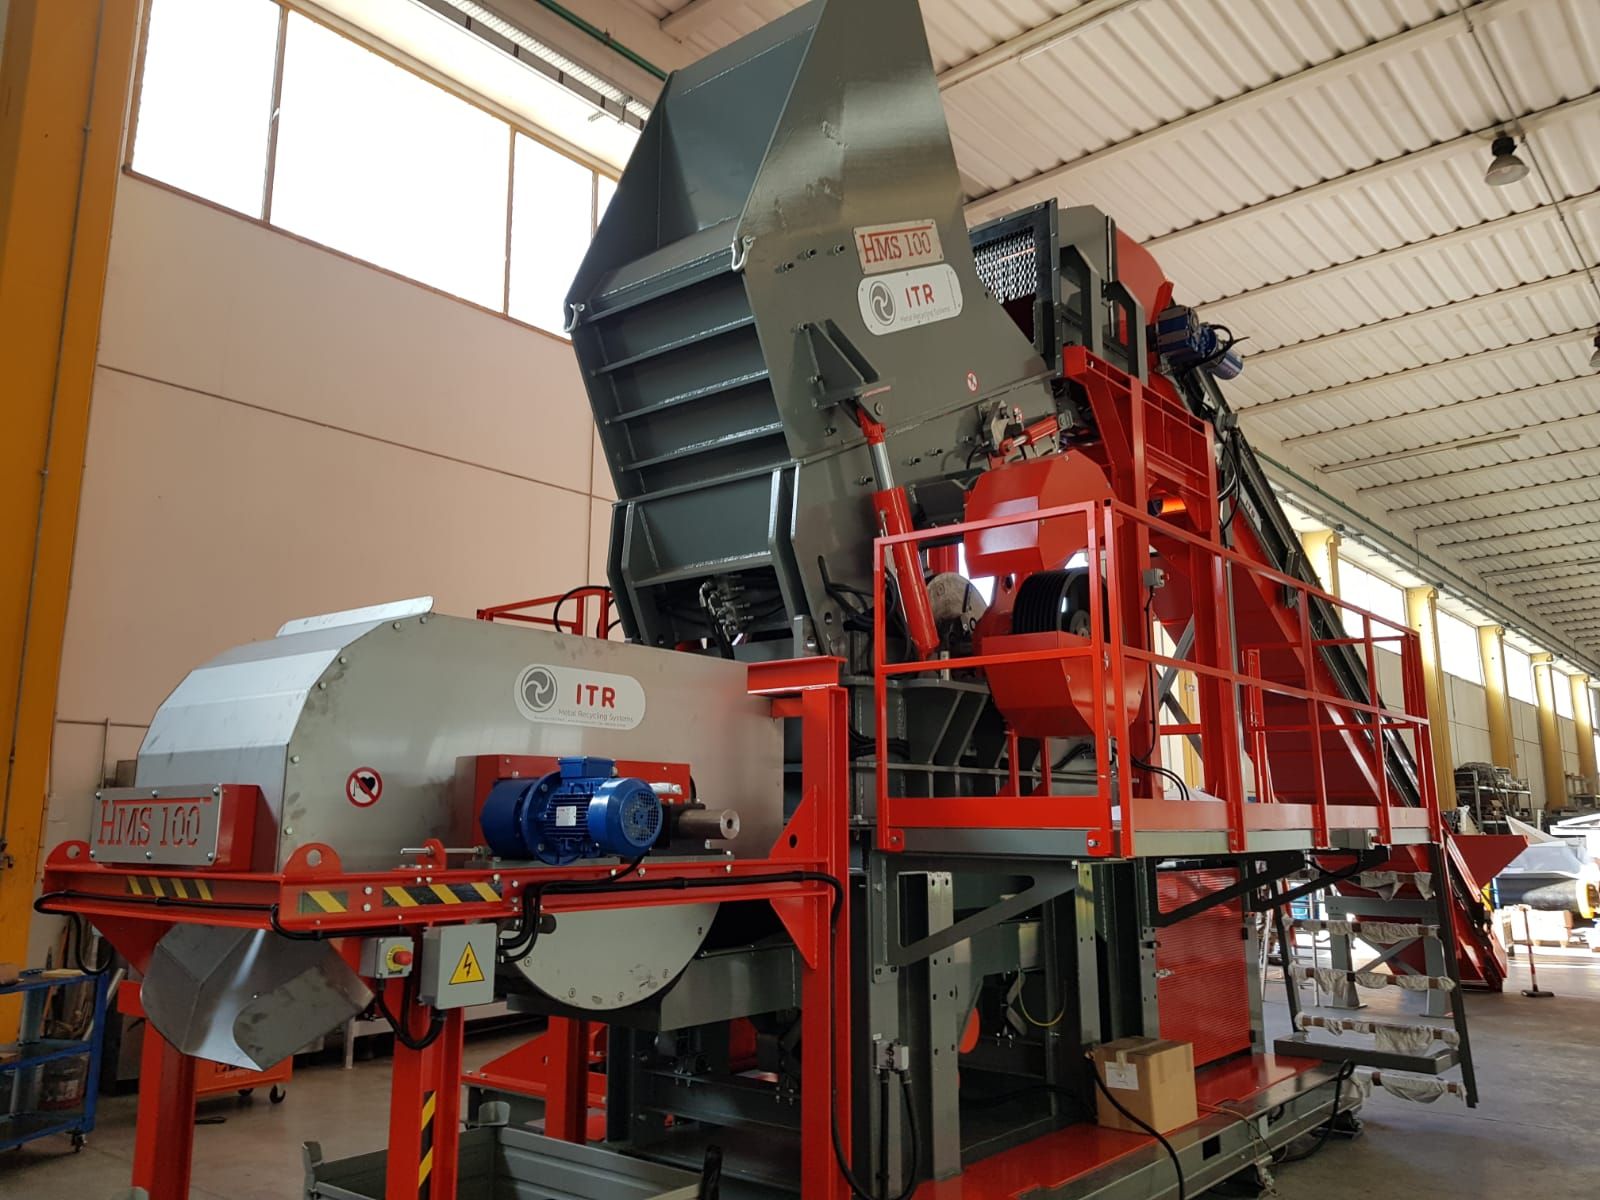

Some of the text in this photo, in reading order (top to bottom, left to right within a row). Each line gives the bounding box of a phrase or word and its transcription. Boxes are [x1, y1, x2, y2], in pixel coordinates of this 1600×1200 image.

[860, 231, 932, 263] HMS 100
[905, 283, 935, 308] ITR
[576, 683, 616, 709] ITR
[578, 710, 607, 721] Recycling
[609, 713, 634, 722] Systems
[97, 799, 200, 847] HMS 100
